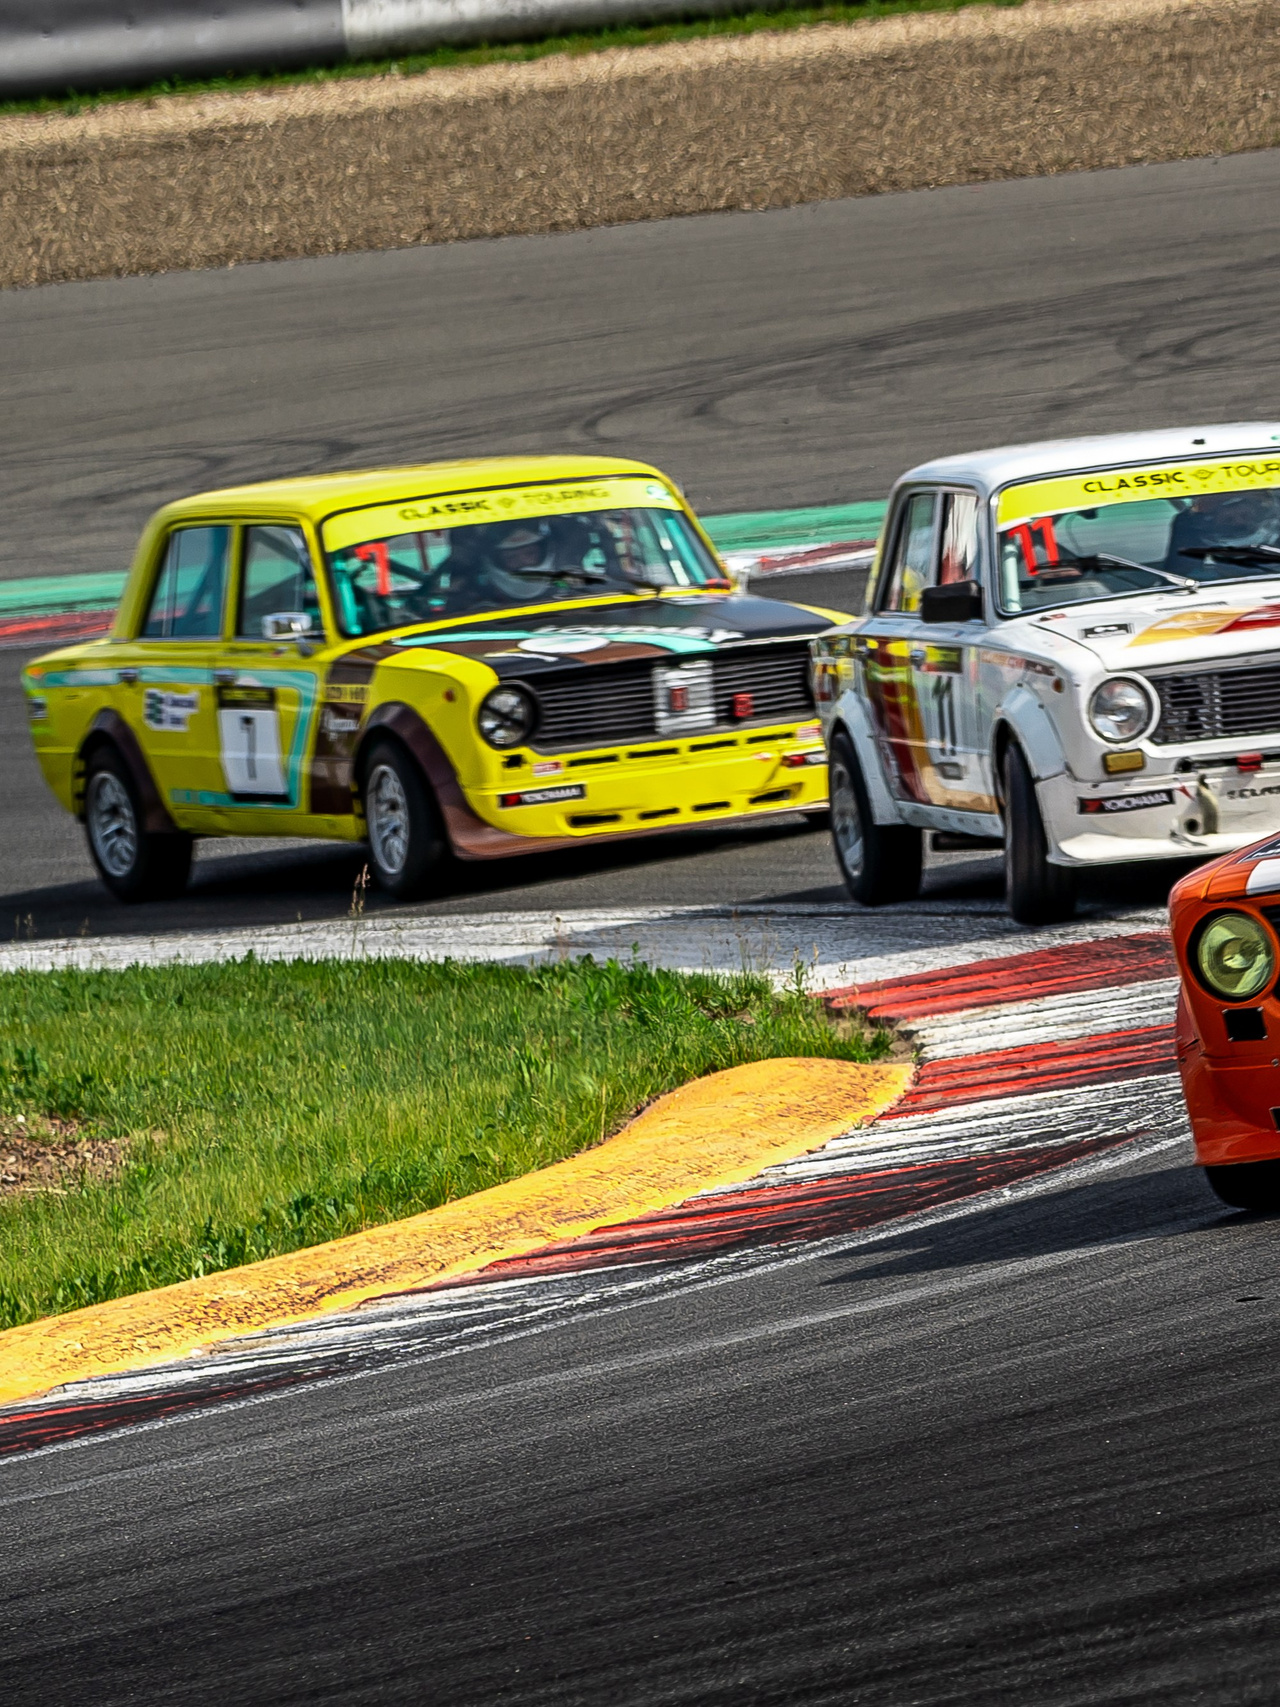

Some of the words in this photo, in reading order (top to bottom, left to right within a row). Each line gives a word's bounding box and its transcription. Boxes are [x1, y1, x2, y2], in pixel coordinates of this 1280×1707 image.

[1084, 471, 1187, 494] CLASSIC
[399, 499, 491, 521] CLASSIC
[1007, 517, 1061, 577] 11
[1101, 791, 1170, 811] YOKOHAMA
